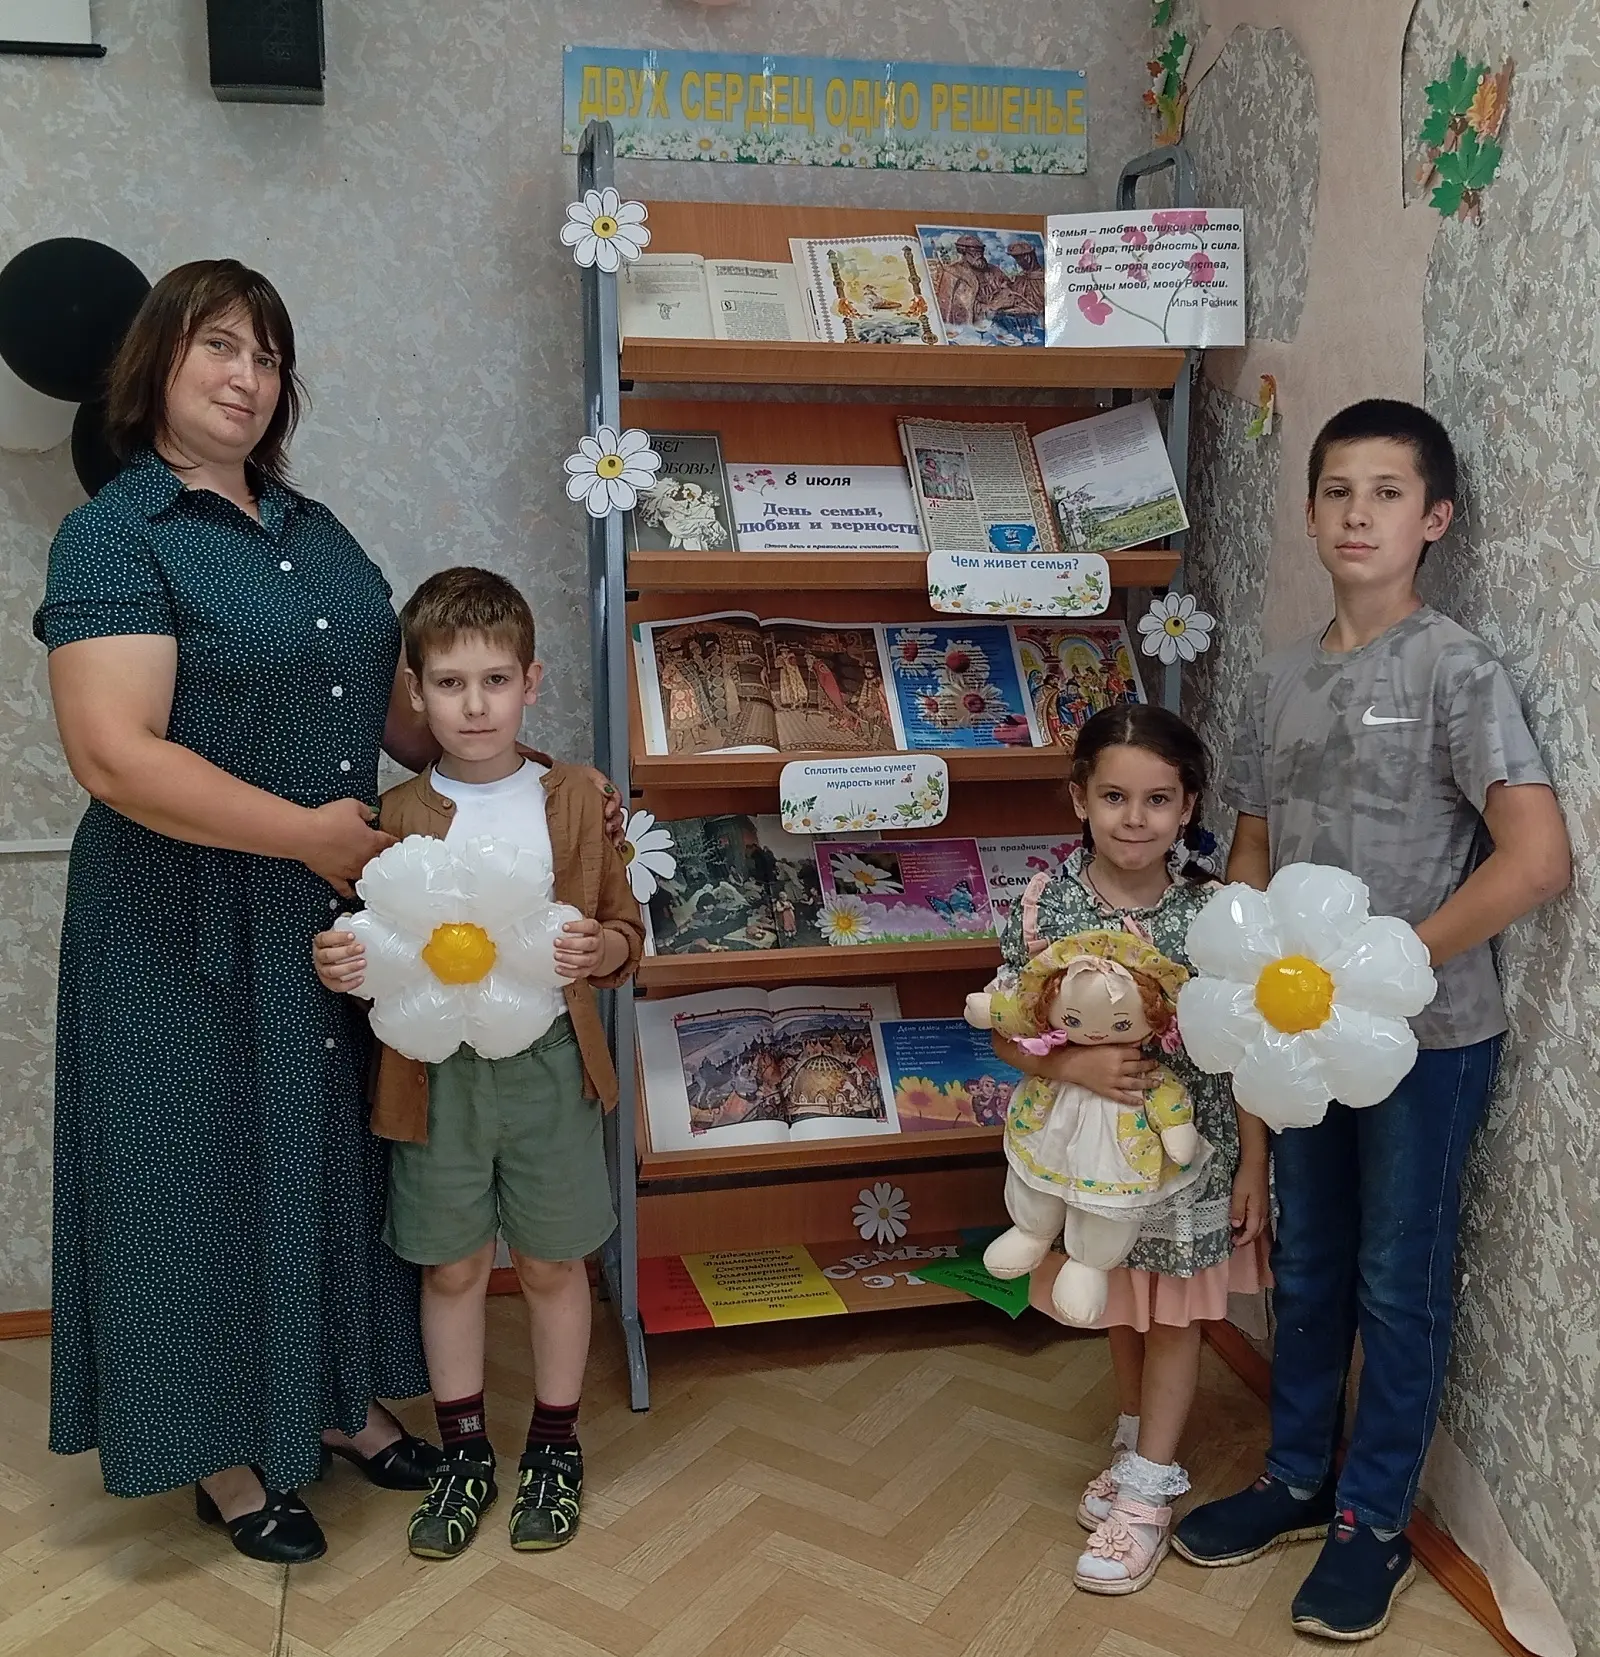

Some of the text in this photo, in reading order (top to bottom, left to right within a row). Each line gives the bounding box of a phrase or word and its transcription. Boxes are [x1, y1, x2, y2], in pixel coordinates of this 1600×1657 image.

[579, 65, 1085, 138] ДВУХ СЕРДЕЦ ОДНО РЕШЕНЬЕ
[1052, 229, 1087, 238] Семья
[1099, 226, 1138, 236] любви
[1189, 222, 1242, 234] царство,
[1066, 245, 1085, 256] ней
[1089, 245, 1119, 255] вера,
[1121, 241, 1198, 253] праведность
[1201, 242, 1208, 250] и
[1210, 241, 1240, 251] сила.
[1066, 264, 1102, 274] Семья
[1114, 263, 1149, 273] опора
[1151, 259, 1229, 271] государства,
[1068, 278, 1228, 293] Страны моей, моей России.
[1172, 297, 1238, 308] Илья Резник
[785, 471, 851, 488] 8 июля
[763, 502, 883, 518] День семьи,
[737, 519, 919, 536] любви и верности
[951, 555, 1079, 571] Чем живет семья?
[804, 763, 917, 776] Сплотить семью сумеет
[826, 778, 896, 790] мудрость книг
[1001, 843, 1049, 852] праздника:
[709, 1249, 781, 1259] Надежность
[716, 1261, 789, 1272] Сострадание
[822, 1245, 960, 1280] СЕМЬЯ
[712, 1266, 800, 1279] Долготерпение
[725, 1280, 802, 1291] Великодушие
[742, 1288, 793, 1297] Радушие
